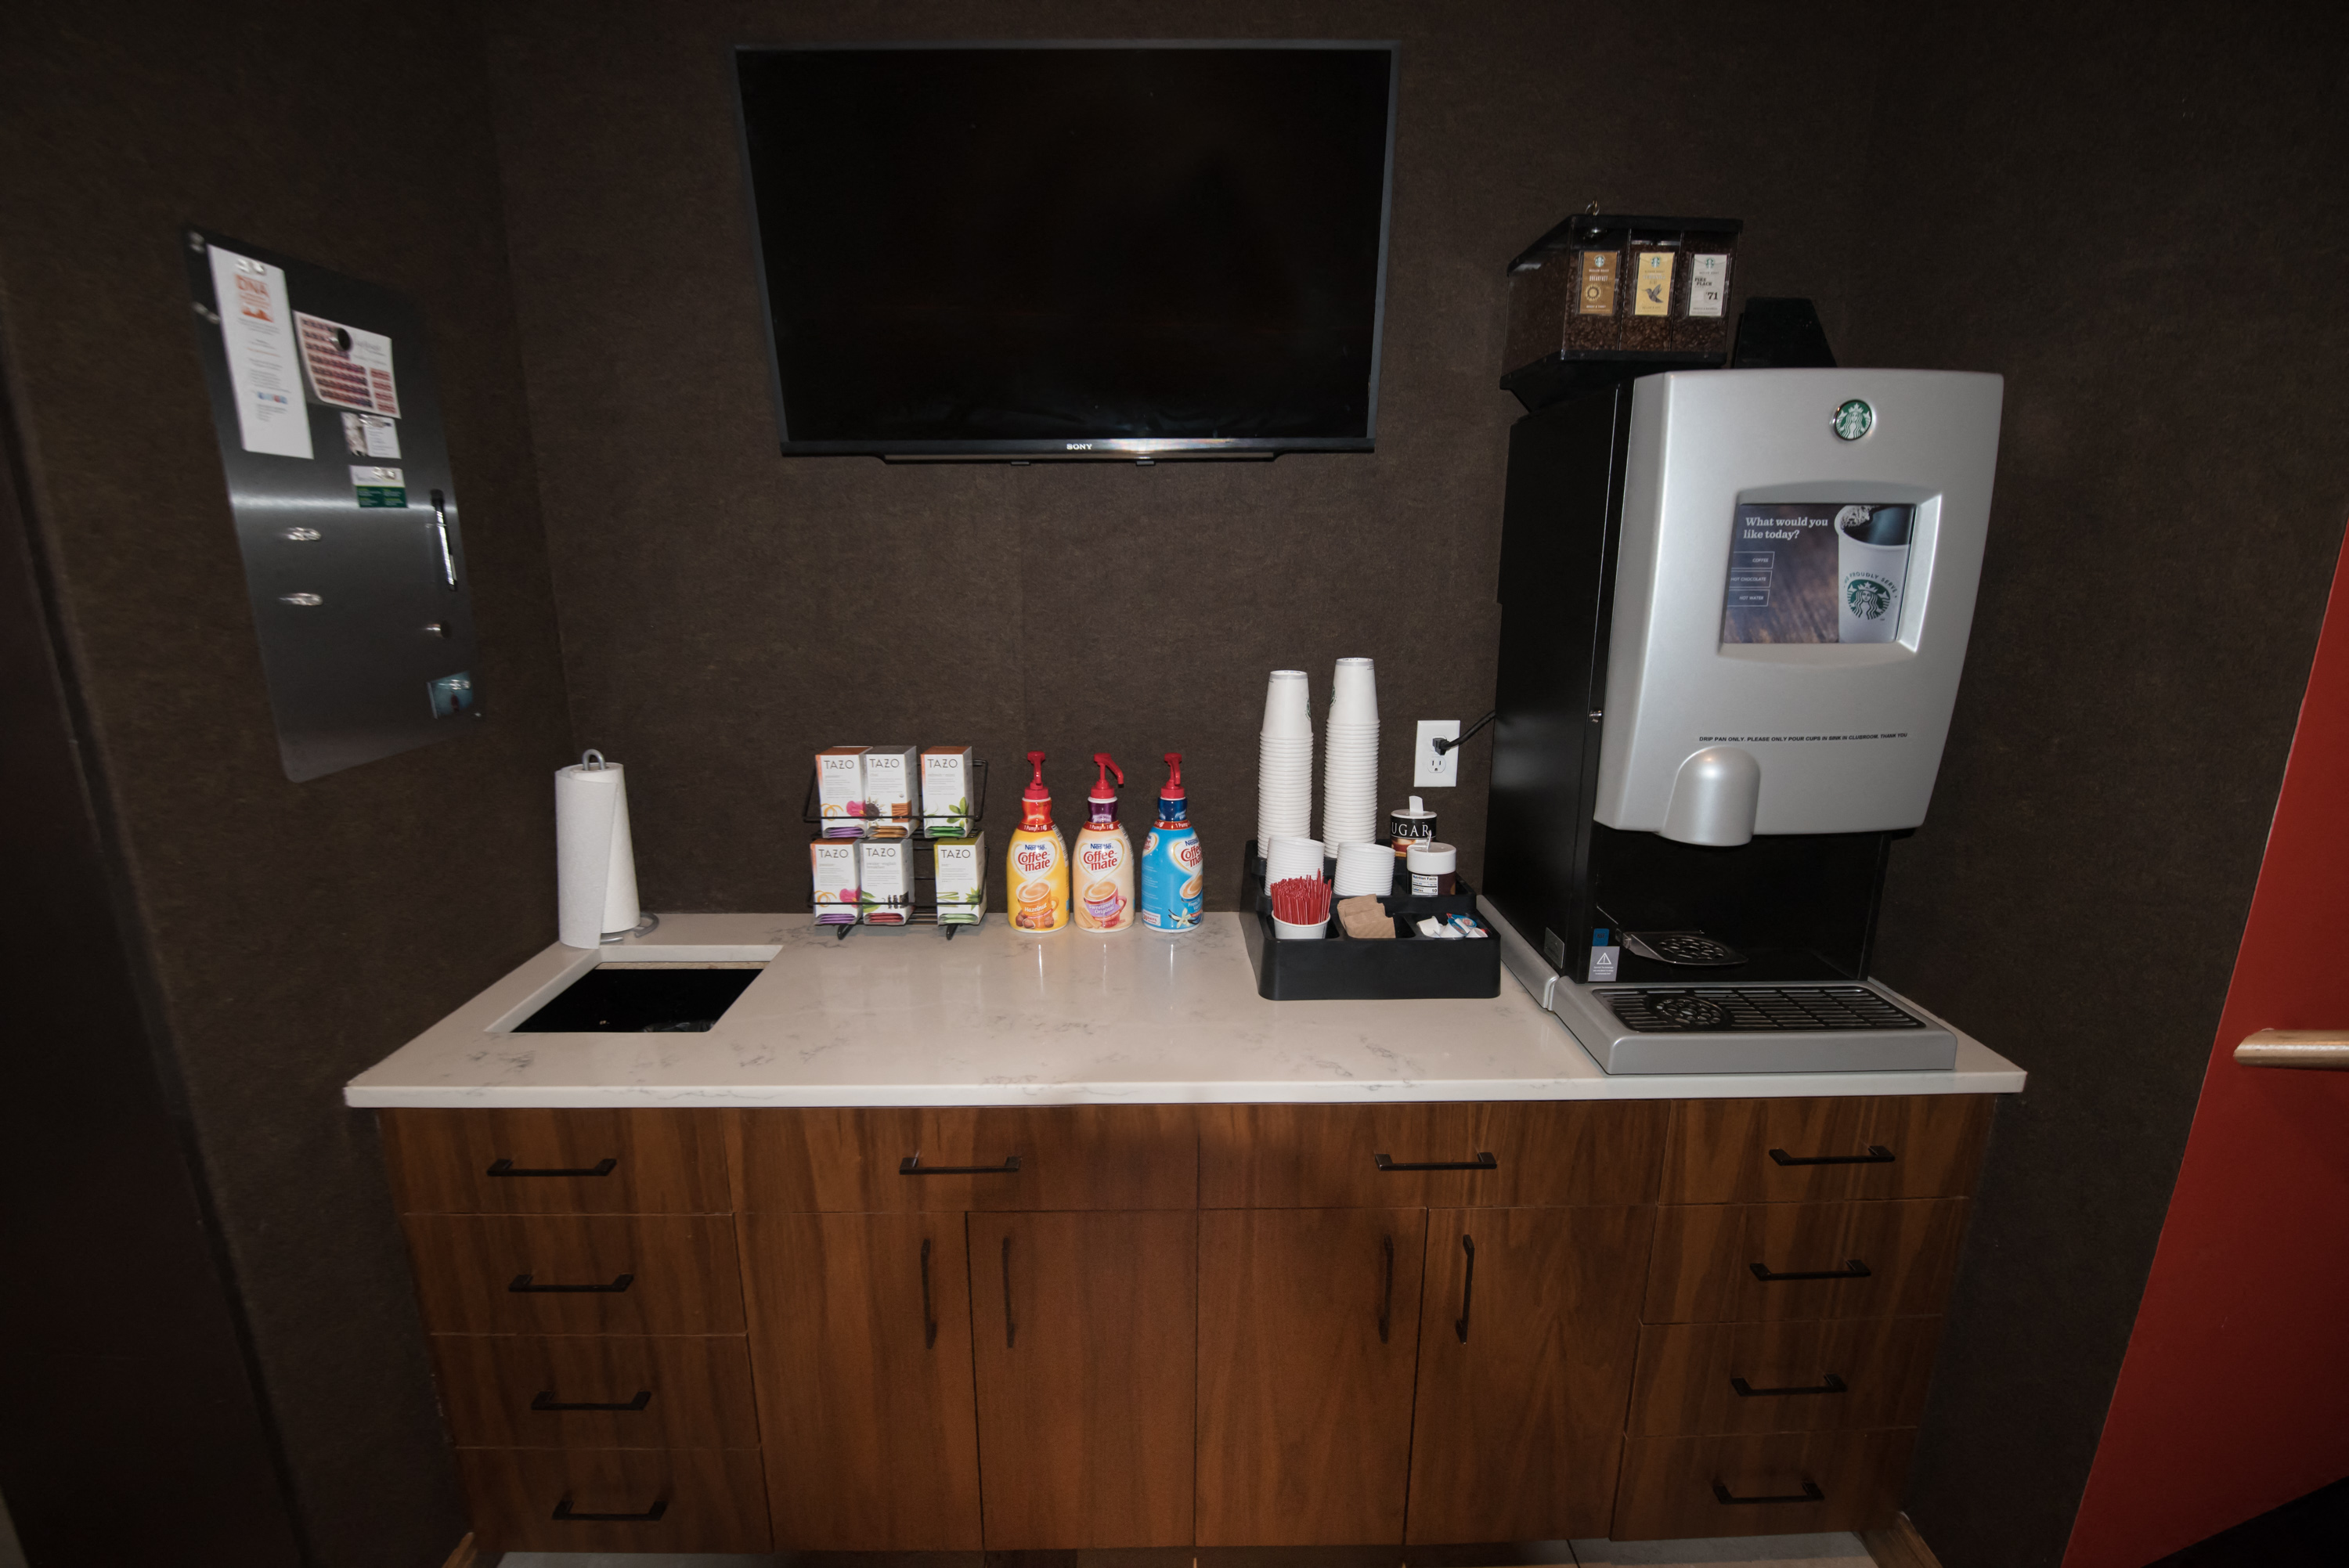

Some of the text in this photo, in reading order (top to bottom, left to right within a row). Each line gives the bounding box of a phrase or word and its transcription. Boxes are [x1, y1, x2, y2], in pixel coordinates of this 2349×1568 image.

[236, 275, 270, 297] DNA
[1745, 517, 1828, 528] What would you
[1743, 529, 1800, 541] like today?
[1881, 577, 1898, 593] SERVE
[823, 759, 855, 770] TAZO
[868, 759, 900, 768] TAZO
[927, 759, 958, 768] TAZO
[1391, 822, 1429, 836] UGAR
[818, 849, 849, 858] TAZO
[865, 848, 896, 857] TAZO
[940, 849, 971, 859] TAZO
[1025, 859, 1050, 871] mate
[1091, 857, 1117, 871] mate
[1024, 903, 1047, 912] Hazelnut
[1089, 899, 1113, 910] Sweetened
[1095, 904, 1114, 914] Original
